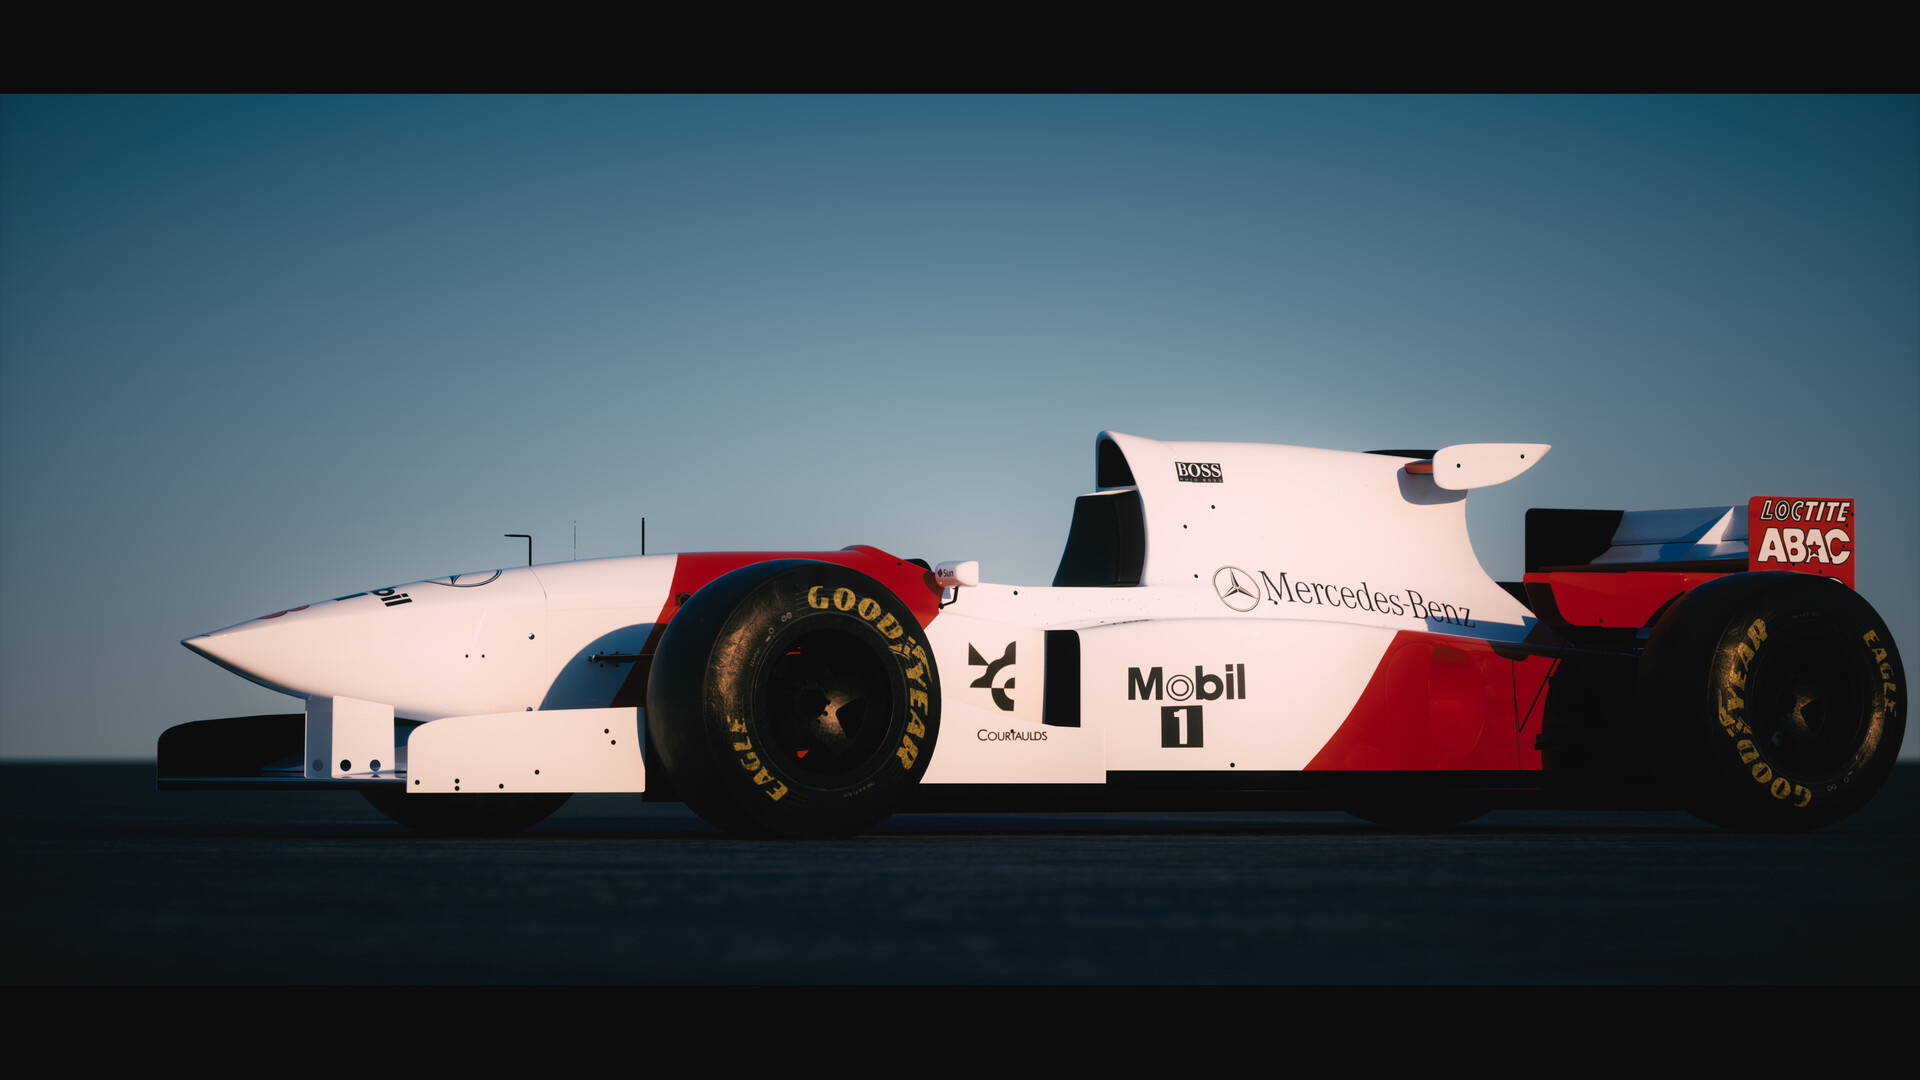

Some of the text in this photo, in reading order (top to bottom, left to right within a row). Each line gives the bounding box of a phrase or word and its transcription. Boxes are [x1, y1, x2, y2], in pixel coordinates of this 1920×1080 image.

[1177, 463, 1221, 477] BOSS
[1759, 499, 1851, 523] LOCTITE
[1757, 527, 1851, 565] ABAC
[943, 569, 954, 577] Sun
[1257, 570, 1476, 629] Mercedes-Benz
[1128, 663, 1246, 701] Mobil
[1863, 629, 1897, 717] EAGLE
[1173, 708, 1188, 745] 1
[726, 715, 788, 800] EAGLE
